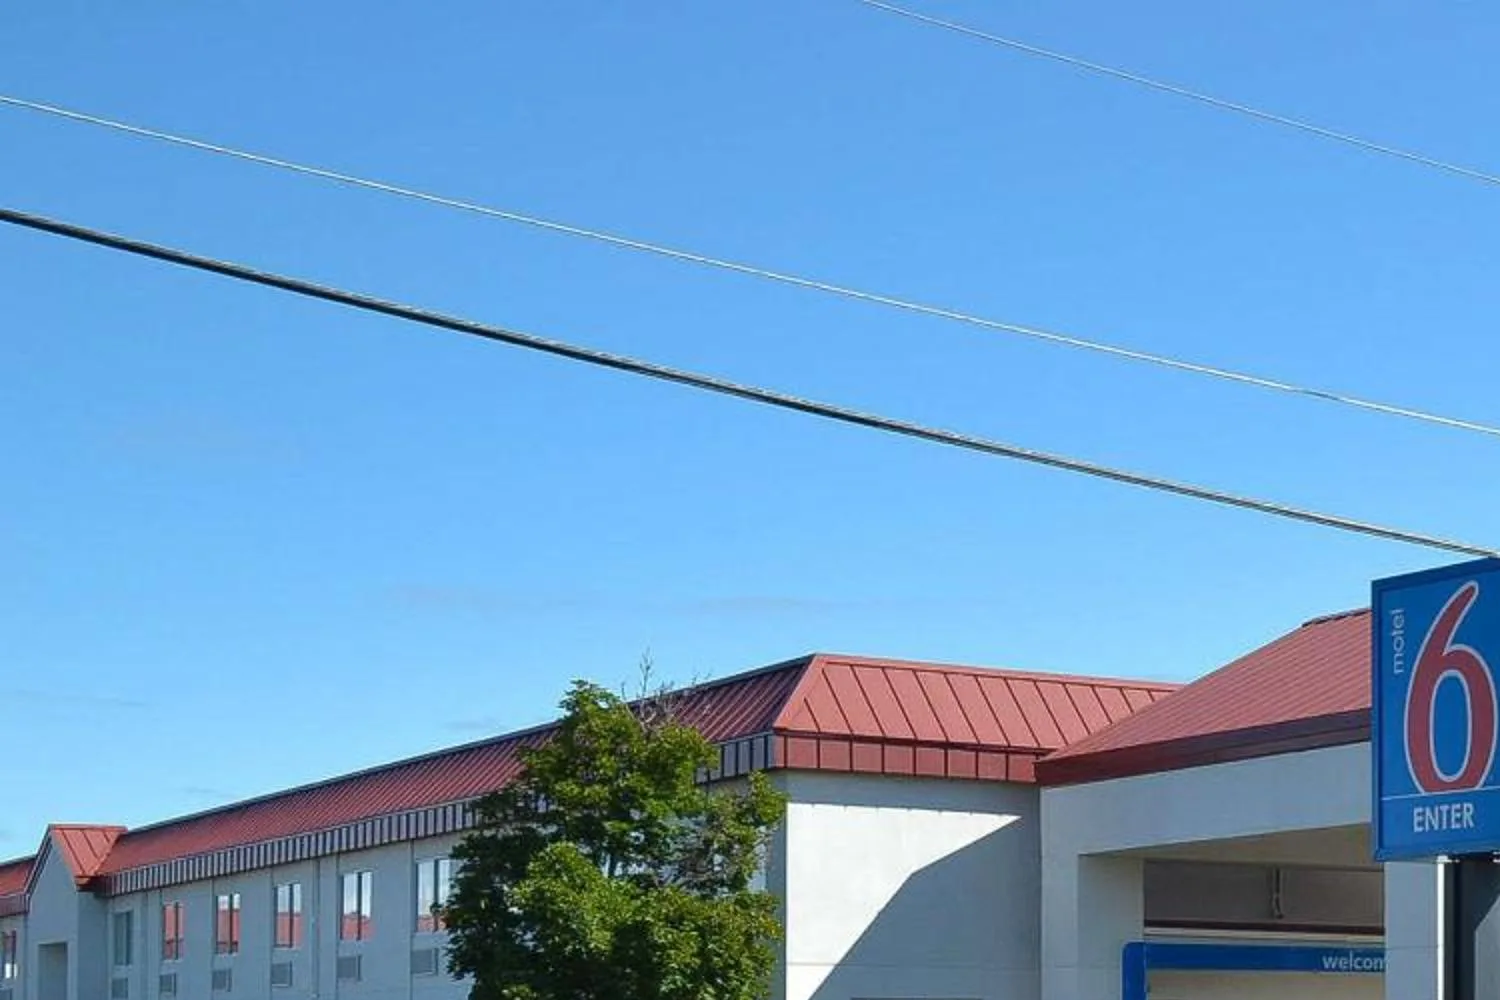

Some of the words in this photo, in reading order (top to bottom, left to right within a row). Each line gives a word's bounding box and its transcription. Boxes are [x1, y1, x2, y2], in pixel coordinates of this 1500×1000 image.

[1390, 608, 1405, 674] motel
[1403, 580, 1499, 795] 6
[1413, 802, 1475, 833] ENTER
[1322, 949, 1387, 971] welcom
